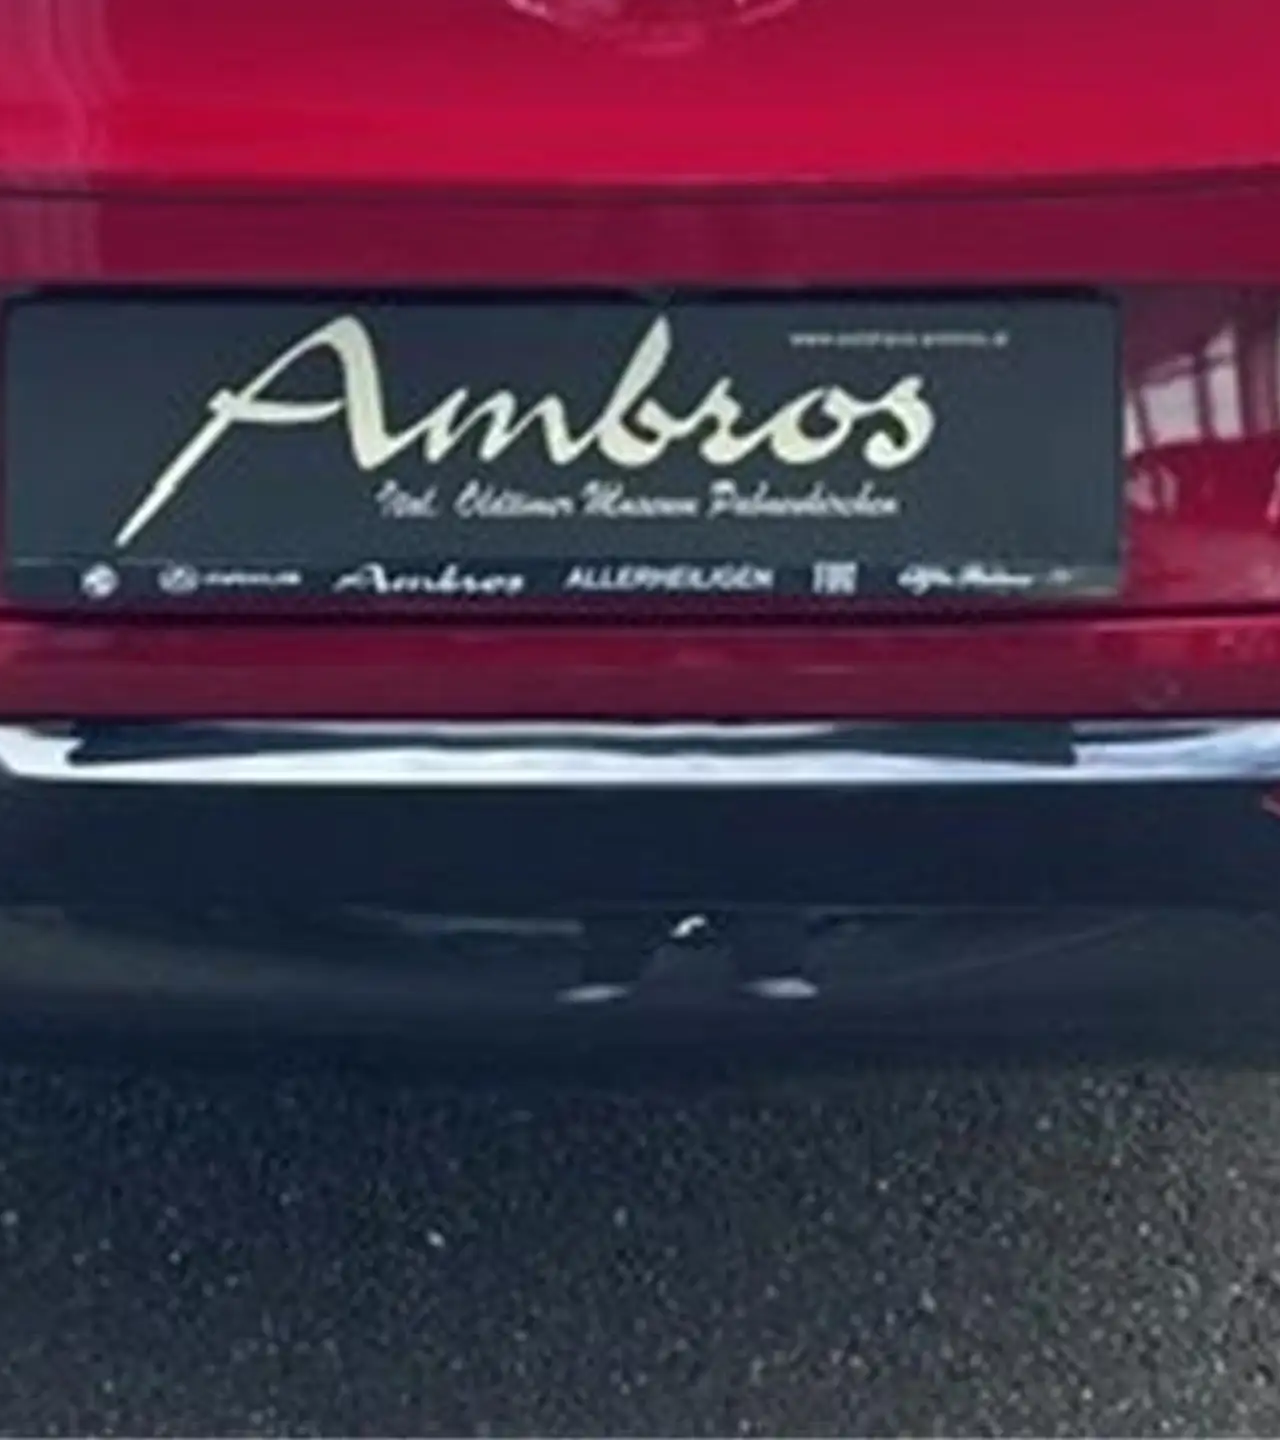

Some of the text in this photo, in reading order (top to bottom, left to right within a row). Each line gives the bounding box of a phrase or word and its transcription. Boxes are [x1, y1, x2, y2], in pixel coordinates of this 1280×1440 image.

[115, 313, 936, 548] Ambros
[332, 563, 524, 594] Ambros
[564, 565, 774, 591] ALLERHEILIGEN
